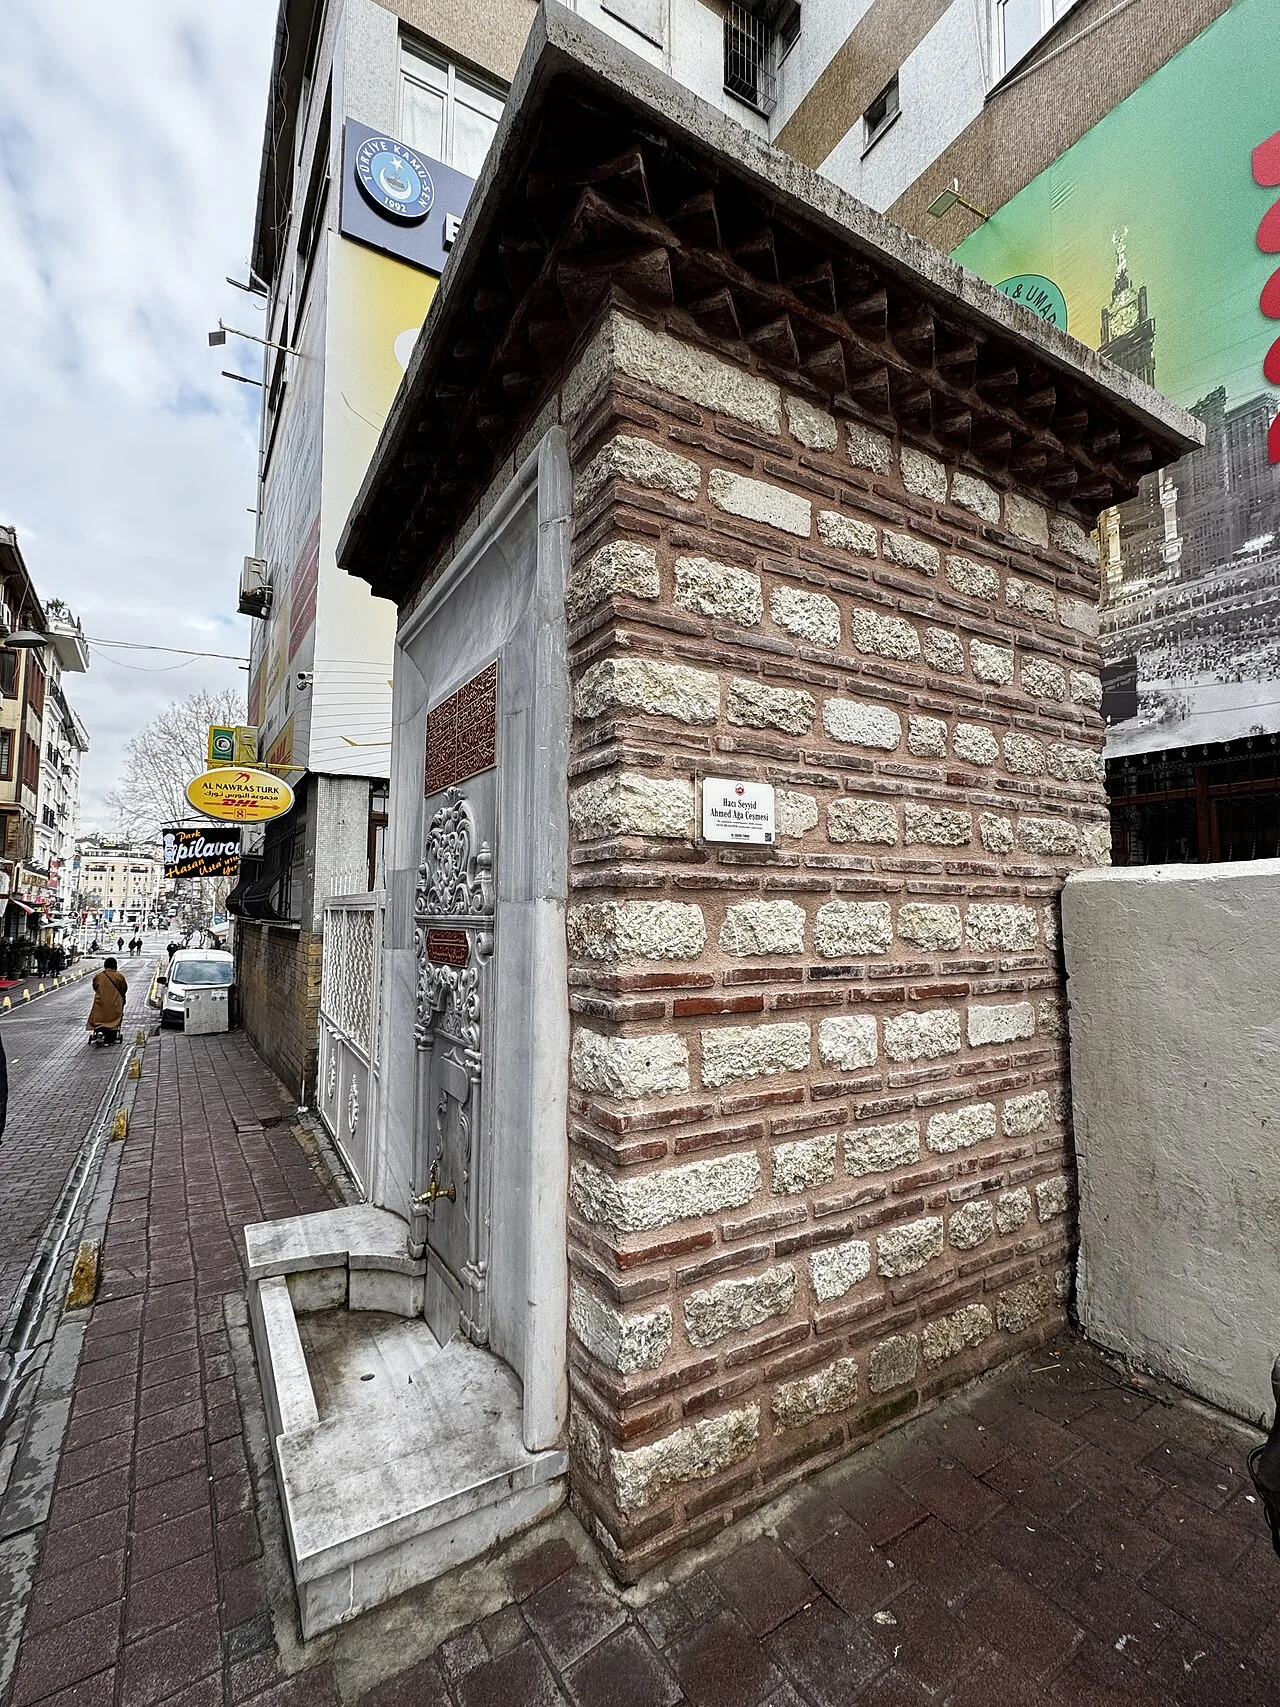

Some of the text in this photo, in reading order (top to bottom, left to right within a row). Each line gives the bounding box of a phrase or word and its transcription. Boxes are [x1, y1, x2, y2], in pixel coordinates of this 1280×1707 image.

[360, 141, 431, 208] TÜRKİYE KAMU-SEN
[384, 196, 407, 213] 1992
[1012, 283, 1023, 298] &
[215, 783, 255, 792] NAWRAS
[256, 785, 279, 794] TURK
[221, 798, 259, 807] DHL
[738, 799, 757, 810] Seyyid
[710, 808, 732, 818] Ahmed
[176, 829, 201, 842] Park
[164, 858, 205, 878] Hasan
